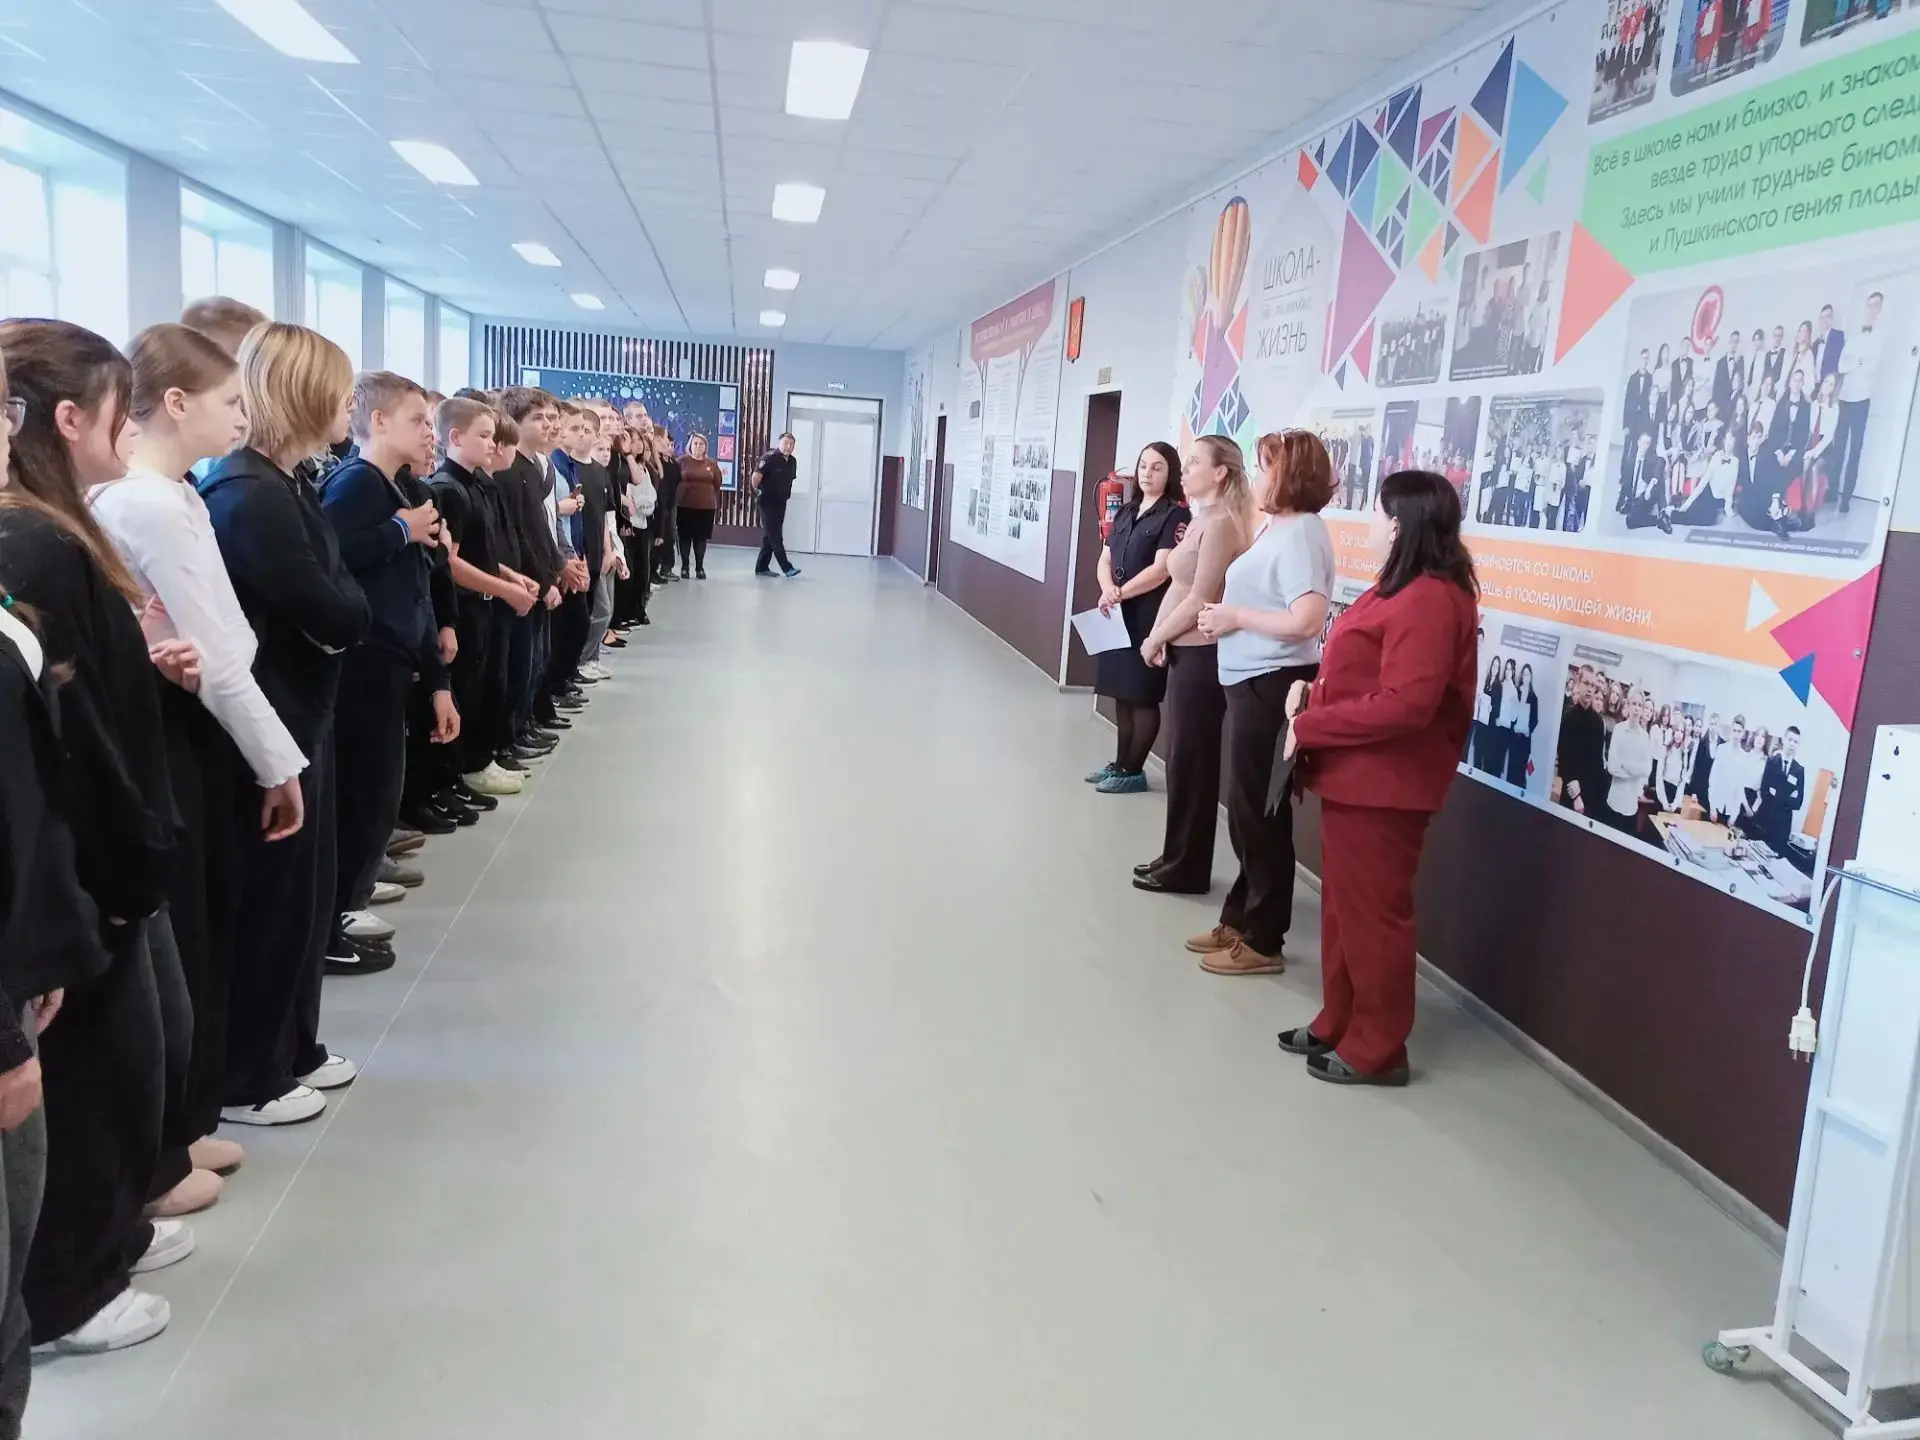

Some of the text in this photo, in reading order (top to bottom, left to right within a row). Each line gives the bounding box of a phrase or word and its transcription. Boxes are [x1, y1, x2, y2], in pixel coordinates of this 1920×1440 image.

[1622, 150, 1630, 166] в
[1634, 132, 1682, 163] школе
[1686, 120, 1721, 145] нам
[1725, 113, 1737, 132] и
[1742, 90, 1812, 127] близко,
[1820, 80, 1835, 102] и
[1650, 92, 1920, 189] везде труда упорного след
[1620, 133, 1920, 229] Здесь мы учили трудные бином
[1649, 235, 1660, 254] и
[1664, 208, 1778, 254] Пушкинского
[1784, 193, 1844, 225] гения
[1256, 320, 1308, 359] ЖИЗНЬ
[1533, 561, 1548, 577] со
[1505, 585, 1512, 598] в
[1514, 586, 1602, 615] последующей
